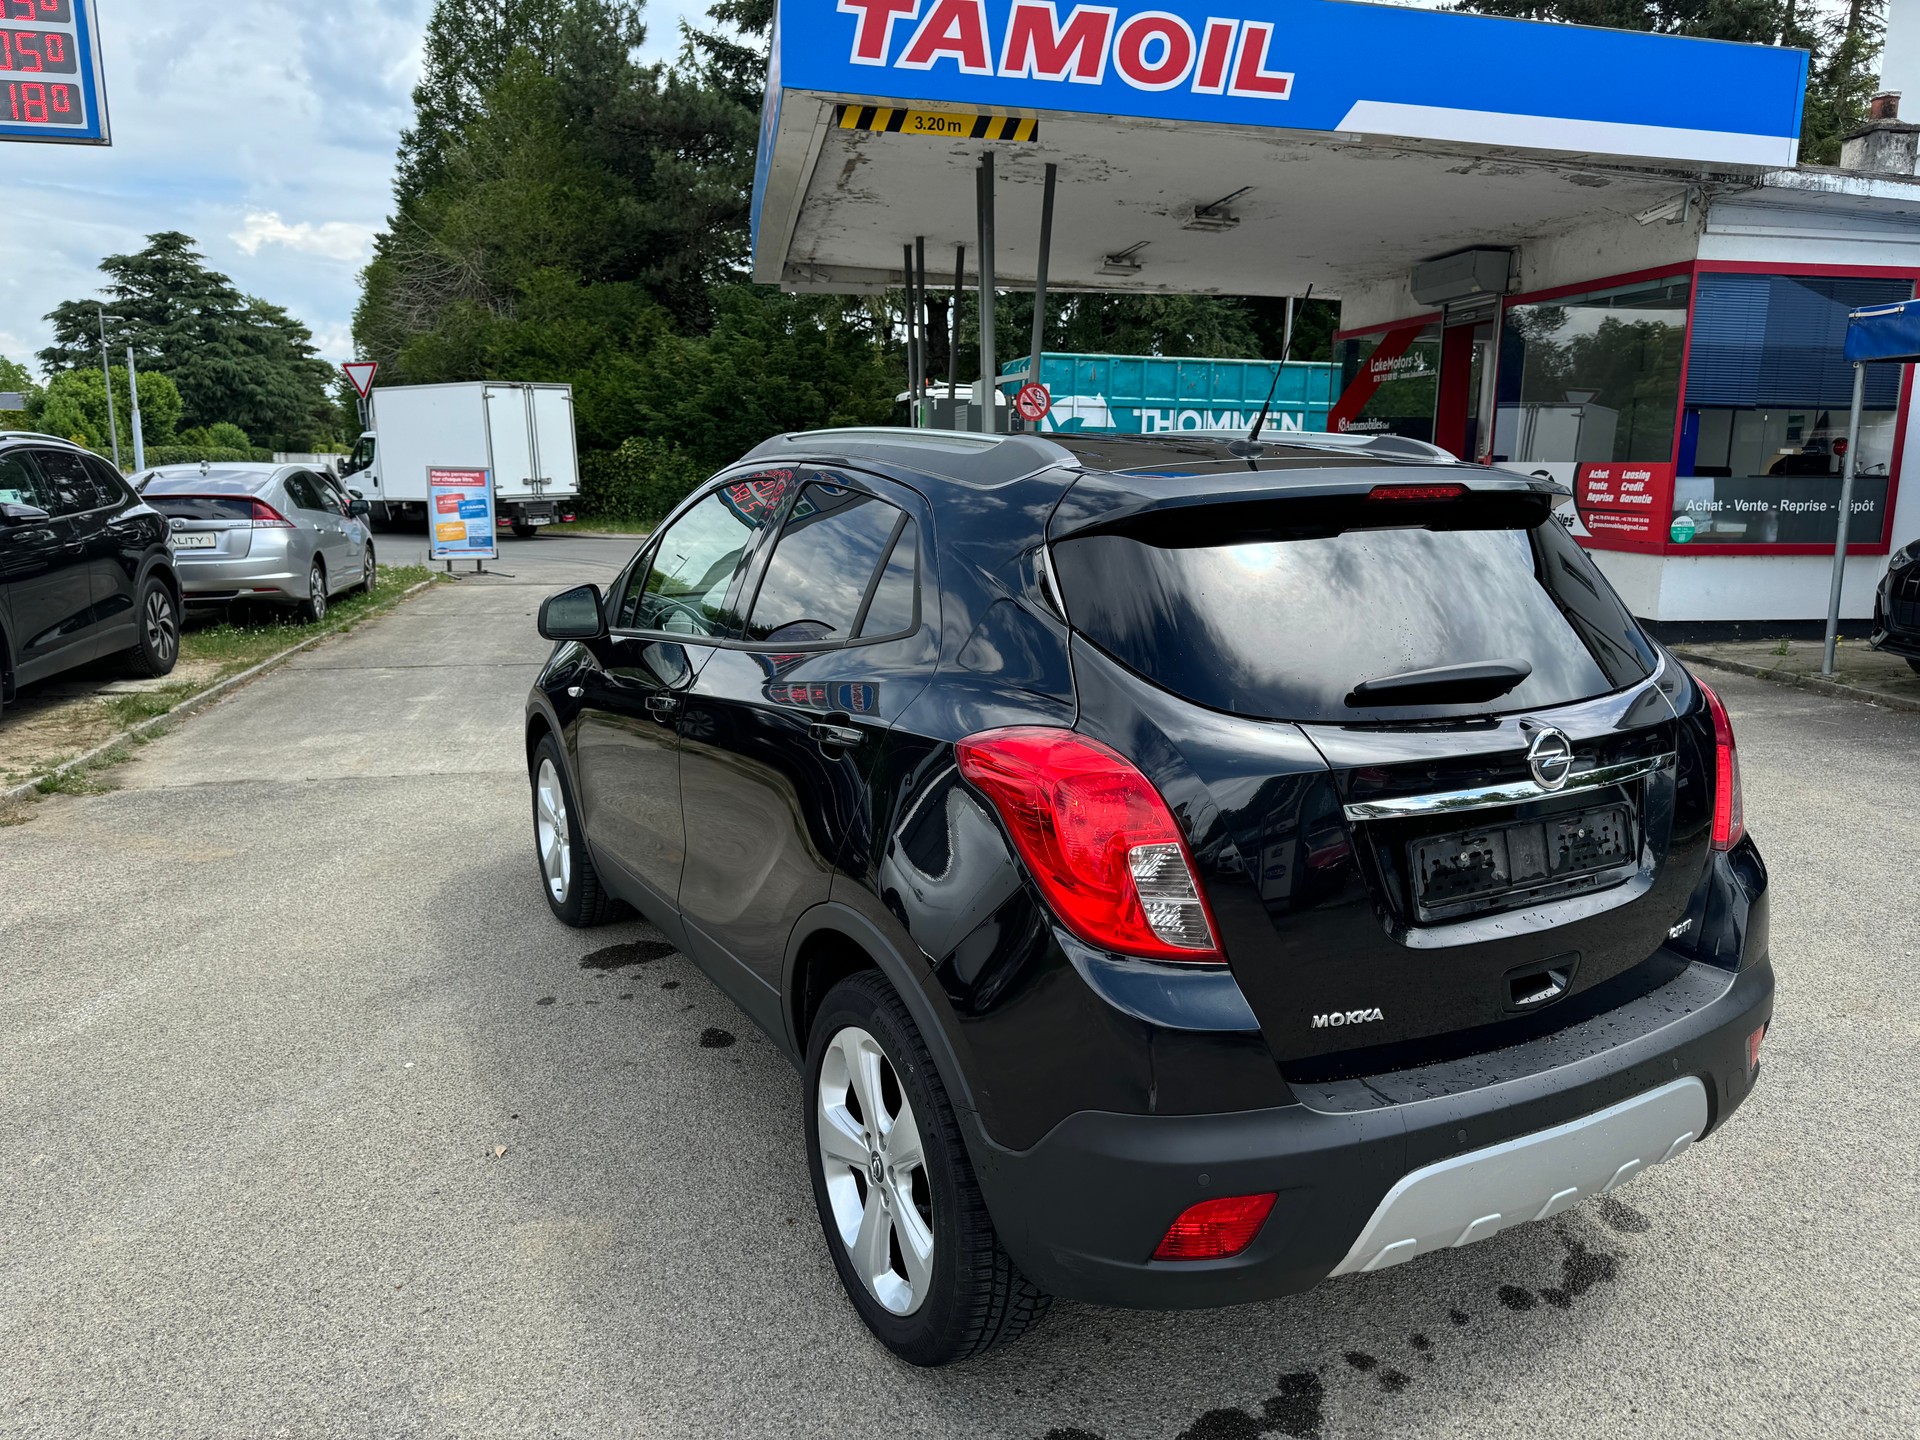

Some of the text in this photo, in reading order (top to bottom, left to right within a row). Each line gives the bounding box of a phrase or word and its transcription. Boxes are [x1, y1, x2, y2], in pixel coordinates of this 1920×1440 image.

[836, 0, 1295, 100] TAMOIL
[914, 116, 962, 133] 3.20 m
[1132, 408, 1304, 434] THOMMEN
[1588, 469, 1609, 478] Achat
[1621, 469, 1651, 481] Leasing
[1588, 481, 1608, 490] Vente
[1586, 492, 1614, 503] Reprise
[1619, 493, 1653, 504] Garantie
[1685, 499, 1723, 512] Achat
[1734, 499, 1769, 512] Vente
[1780, 499, 1827, 514] Reprise
[1310, 1007, 1384, 1028] MOKKA
